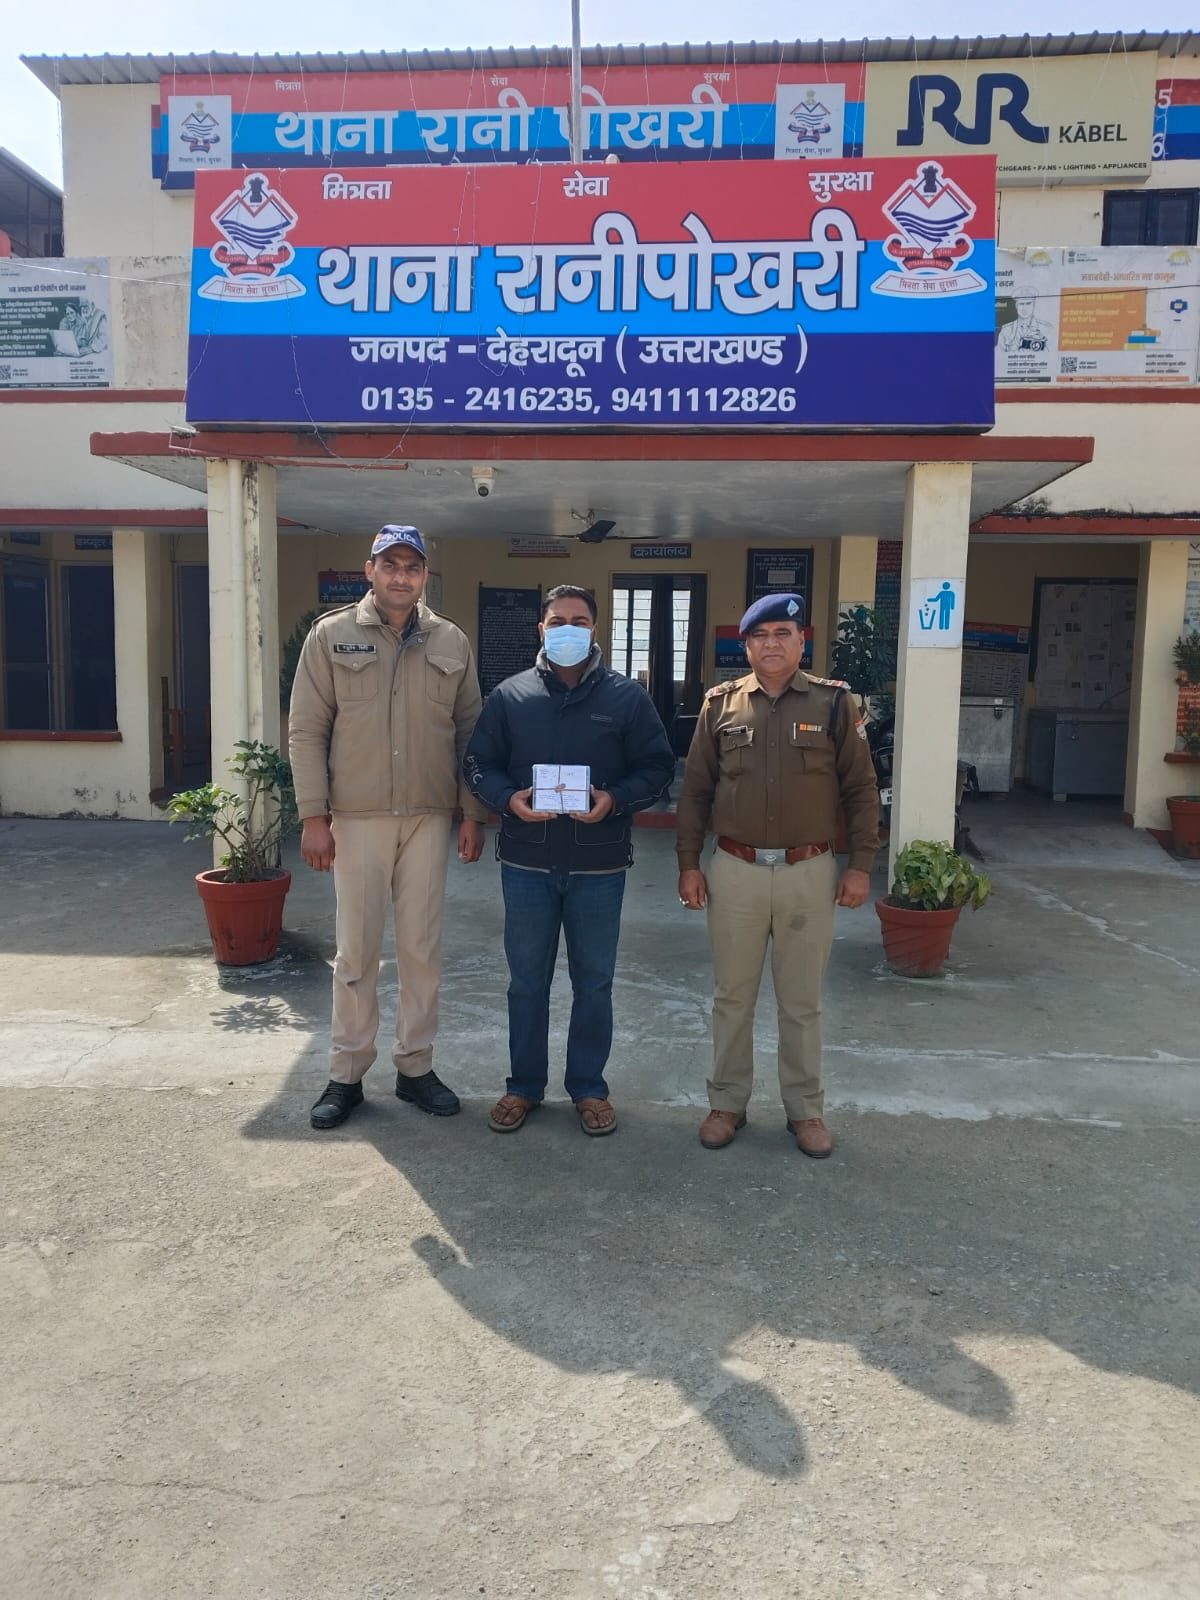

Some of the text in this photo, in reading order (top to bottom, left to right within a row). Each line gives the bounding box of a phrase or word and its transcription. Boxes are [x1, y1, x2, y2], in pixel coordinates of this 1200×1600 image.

[274, 71, 730, 92] मित्रता सेवा सुरक्षा
[1157, 89, 1172, 108] 5
[275, 110, 399, 155] थाना
[415, 87, 535, 153] रानी
[1058, 121, 1128, 144] KĀBEL
[1152, 133, 1164, 158] 6
[1103, 162, 1148, 170] APPLIANCES
[322, 171, 874, 203] मित्रता सेवा सुरक्षा
[317, 208, 867, 315] थाना रानीपोखरी
[349, 336, 450, 363] जनपद
[486, 327, 605, 378] देहरादून
[638, 336, 786, 364] उत्तराखण्ड
[361, 387, 433, 411] 0135
[464, 387, 601, 415] 2416235,
[611, 387, 797, 412] 9411112826
[633, 544, 688, 557] कार्यालय
[328, 584, 353, 593] MAY
